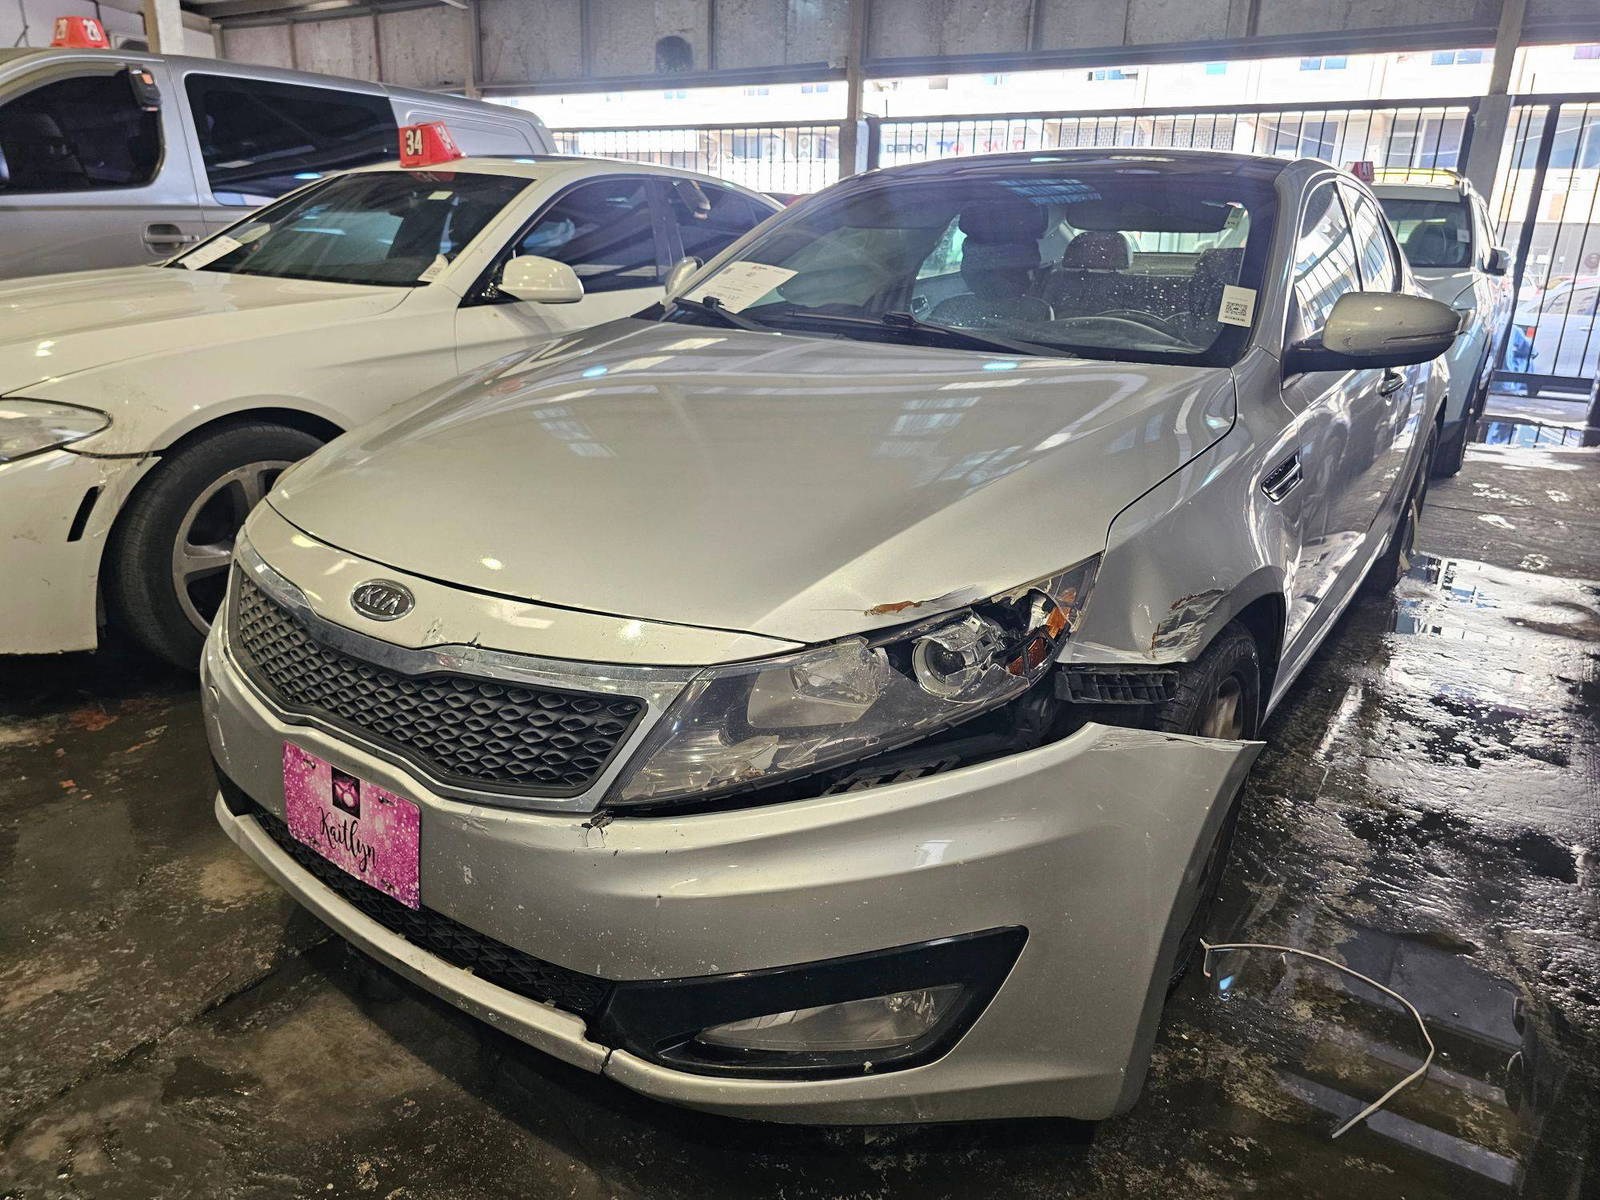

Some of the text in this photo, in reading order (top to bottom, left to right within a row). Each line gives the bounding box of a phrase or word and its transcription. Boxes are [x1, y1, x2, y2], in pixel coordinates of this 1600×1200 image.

[405, 129, 423, 156] 34
[359, 586, 402, 614] KIA
[318, 806, 378, 873] Kaitlyn
